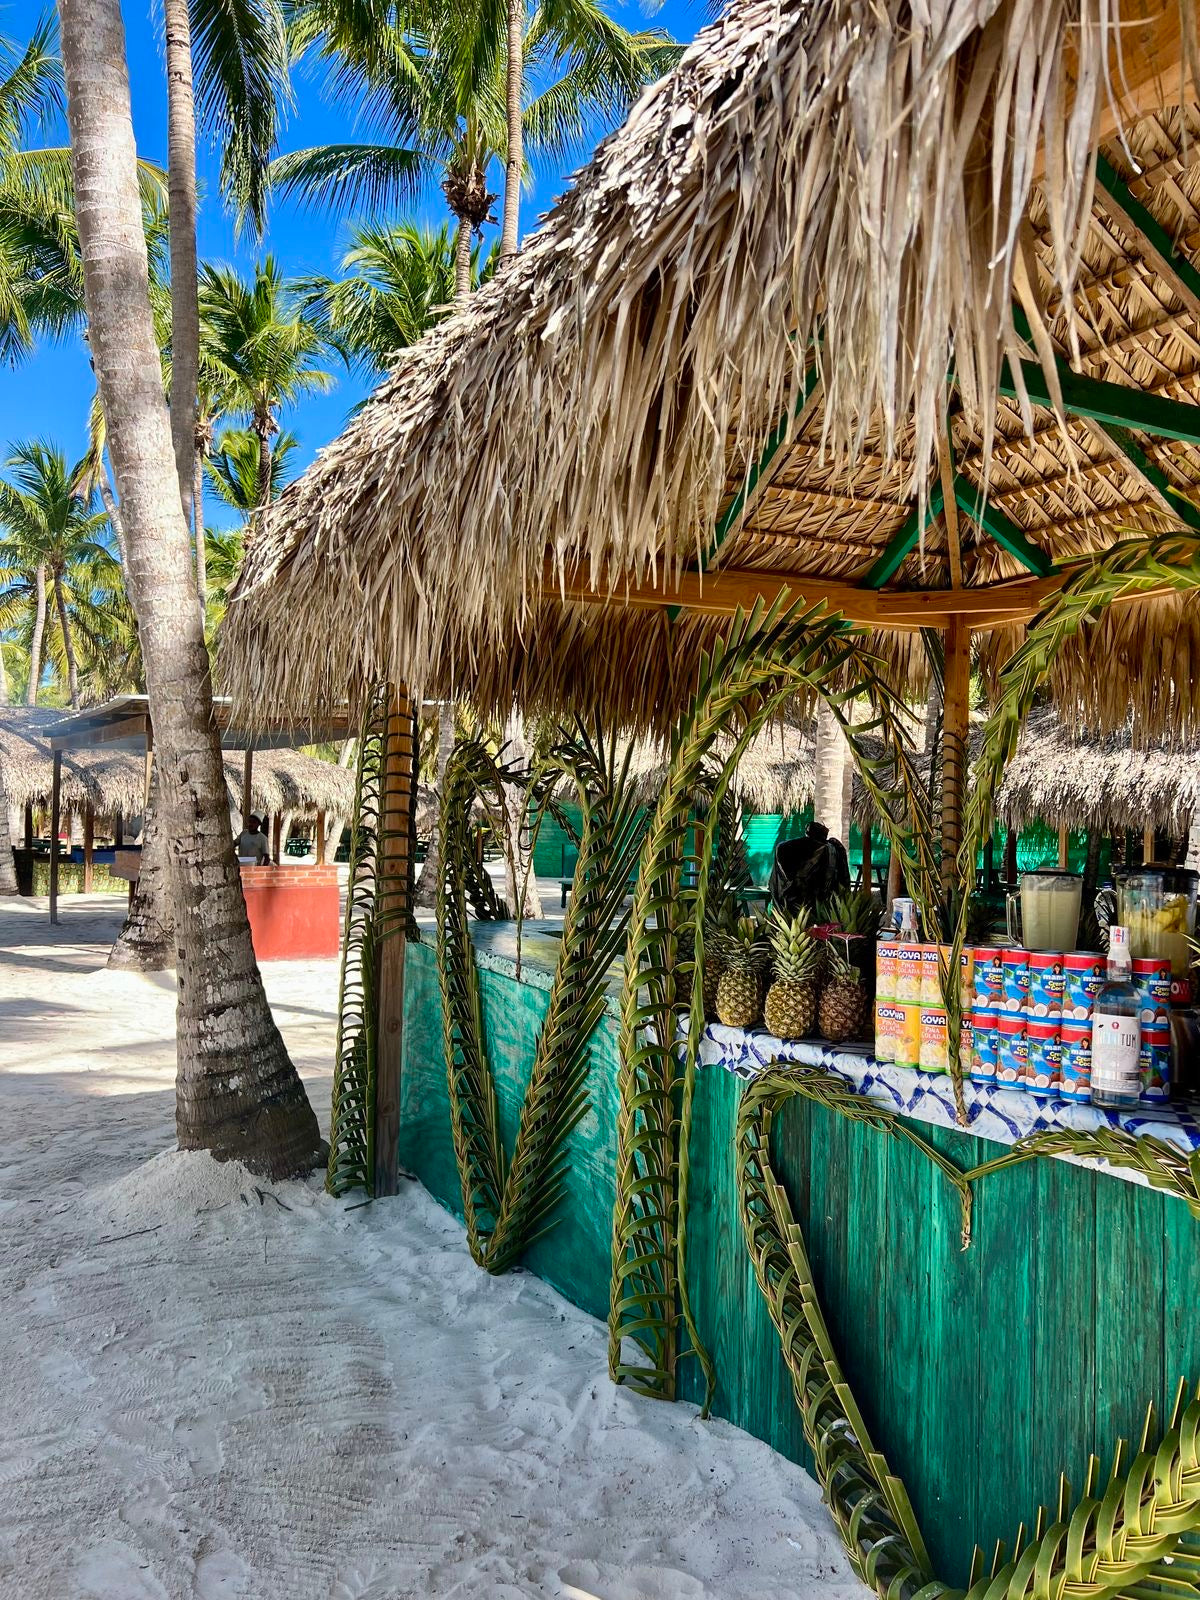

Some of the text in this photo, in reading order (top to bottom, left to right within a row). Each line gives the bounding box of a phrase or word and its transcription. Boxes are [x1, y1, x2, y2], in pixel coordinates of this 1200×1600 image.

[898, 951, 921, 960] GOYA
[923, 952, 938, 961] OYA
[921, 1015, 946, 1025] GOYA
